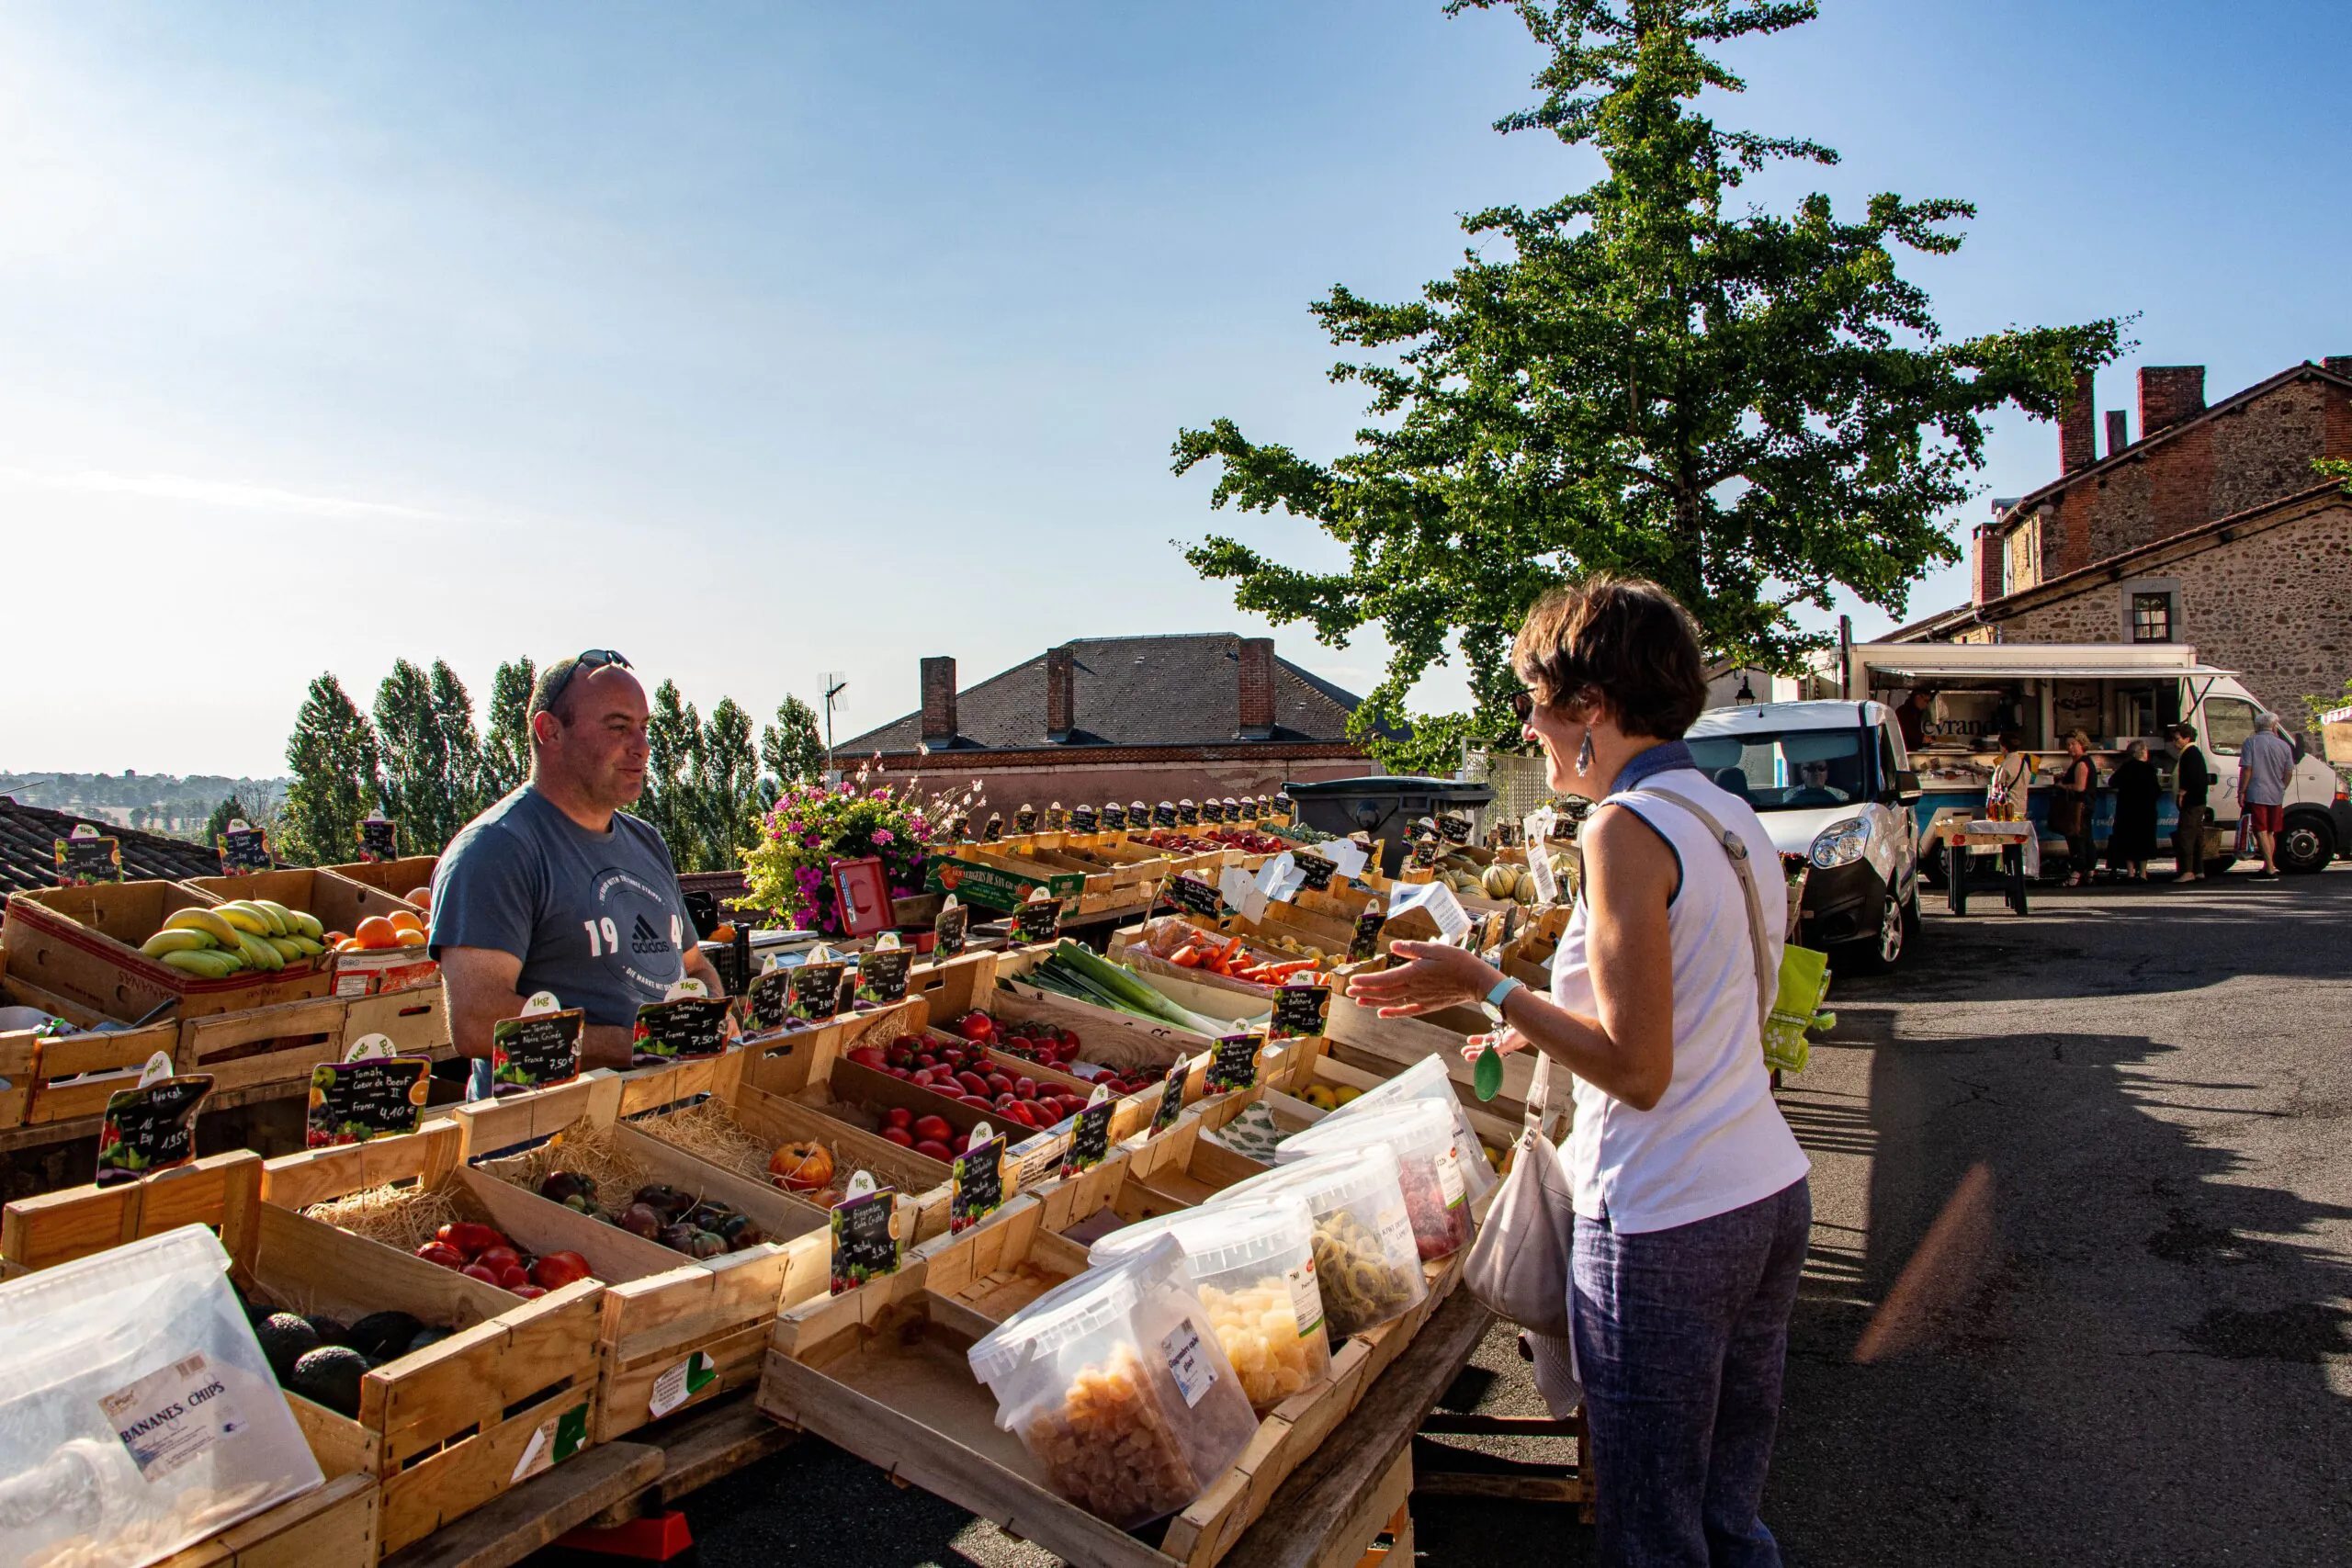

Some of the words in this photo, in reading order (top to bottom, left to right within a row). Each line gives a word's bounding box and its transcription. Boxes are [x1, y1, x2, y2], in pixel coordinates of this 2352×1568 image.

[583, 917, 618, 957] 19
[671, 914, 684, 950] 4
[631, 939, 670, 954] adidas
[626, 967, 637, 979] DIE
[636, 972, 655, 988] MARKE
[680, 982, 698, 991] 1kg
[532, 997, 549, 1007] 1kg
[1236, 1021, 1246, 1031] 1kg
[665, 1030, 686, 1040] France
[354, 1066, 383, 1078] Tomate
[375, 1078, 383, 1088] de
[352, 1101, 376, 1112] France
[975, 1128, 987, 1138] 1kg
[854, 1178, 868, 1190] 1kg
[119, 1403, 185, 1444] BANANES
[187, 1381, 226, 1406] CHIPS
